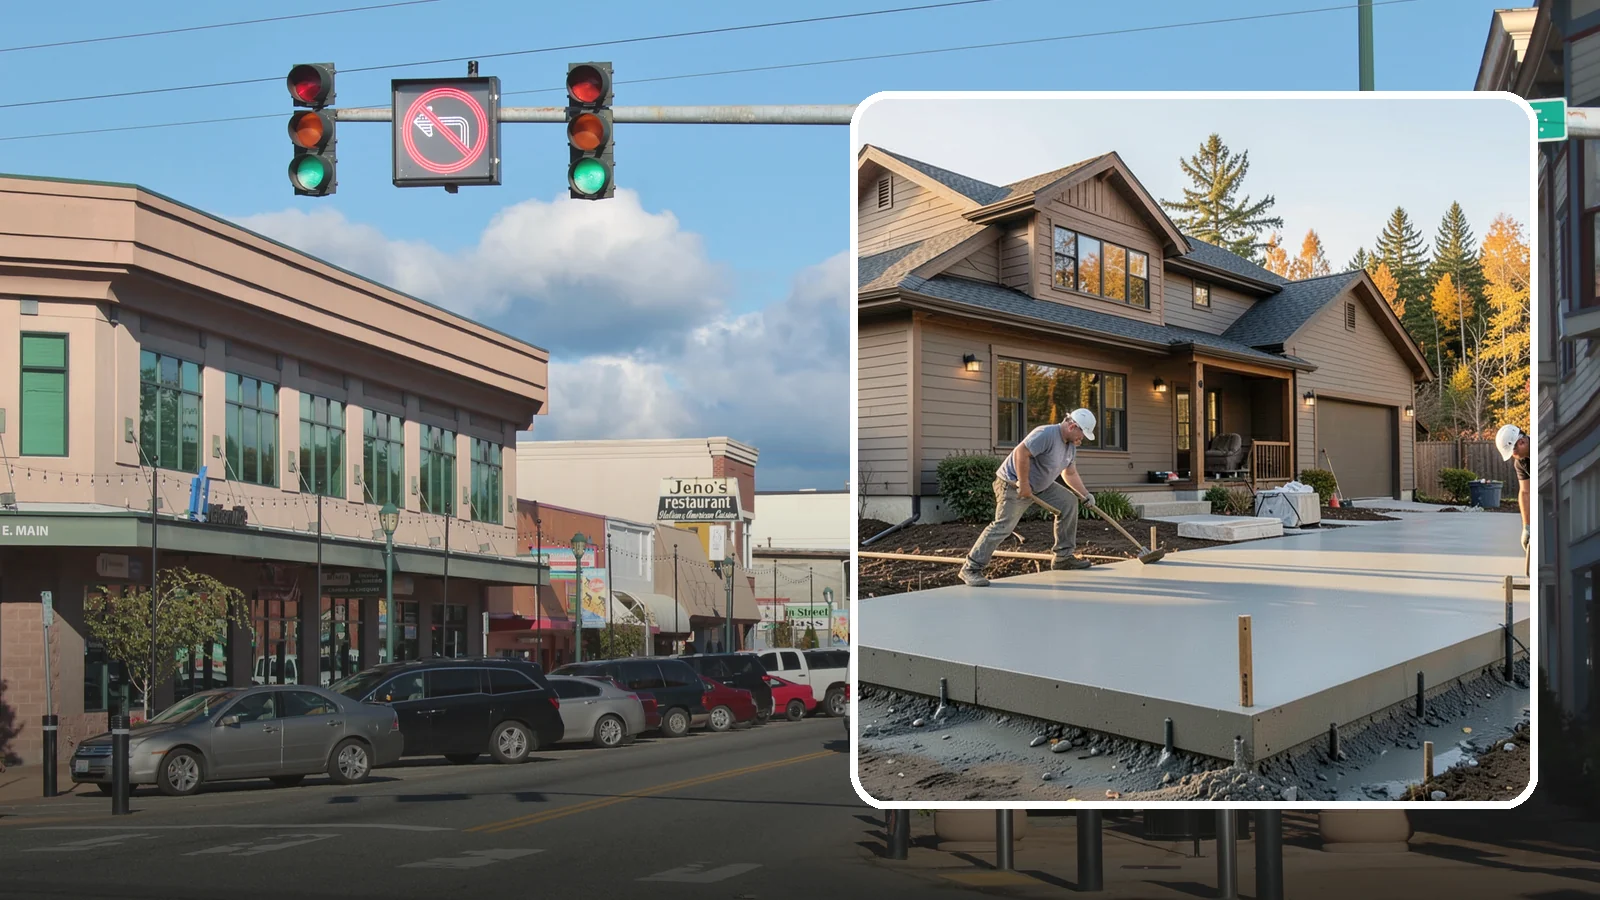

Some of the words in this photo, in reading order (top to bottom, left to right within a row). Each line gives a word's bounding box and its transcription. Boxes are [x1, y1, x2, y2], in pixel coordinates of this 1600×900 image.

[669, 480, 727, 494] Jeno's
[665, 496, 731, 509] restaurant
[686, 510, 714, 519] American
[715, 510, 737, 519] Cuisine
[2, 525, 13, 536] E.
[15, 525, 49, 536] MAIN
[797, 607, 828, 617] Street
